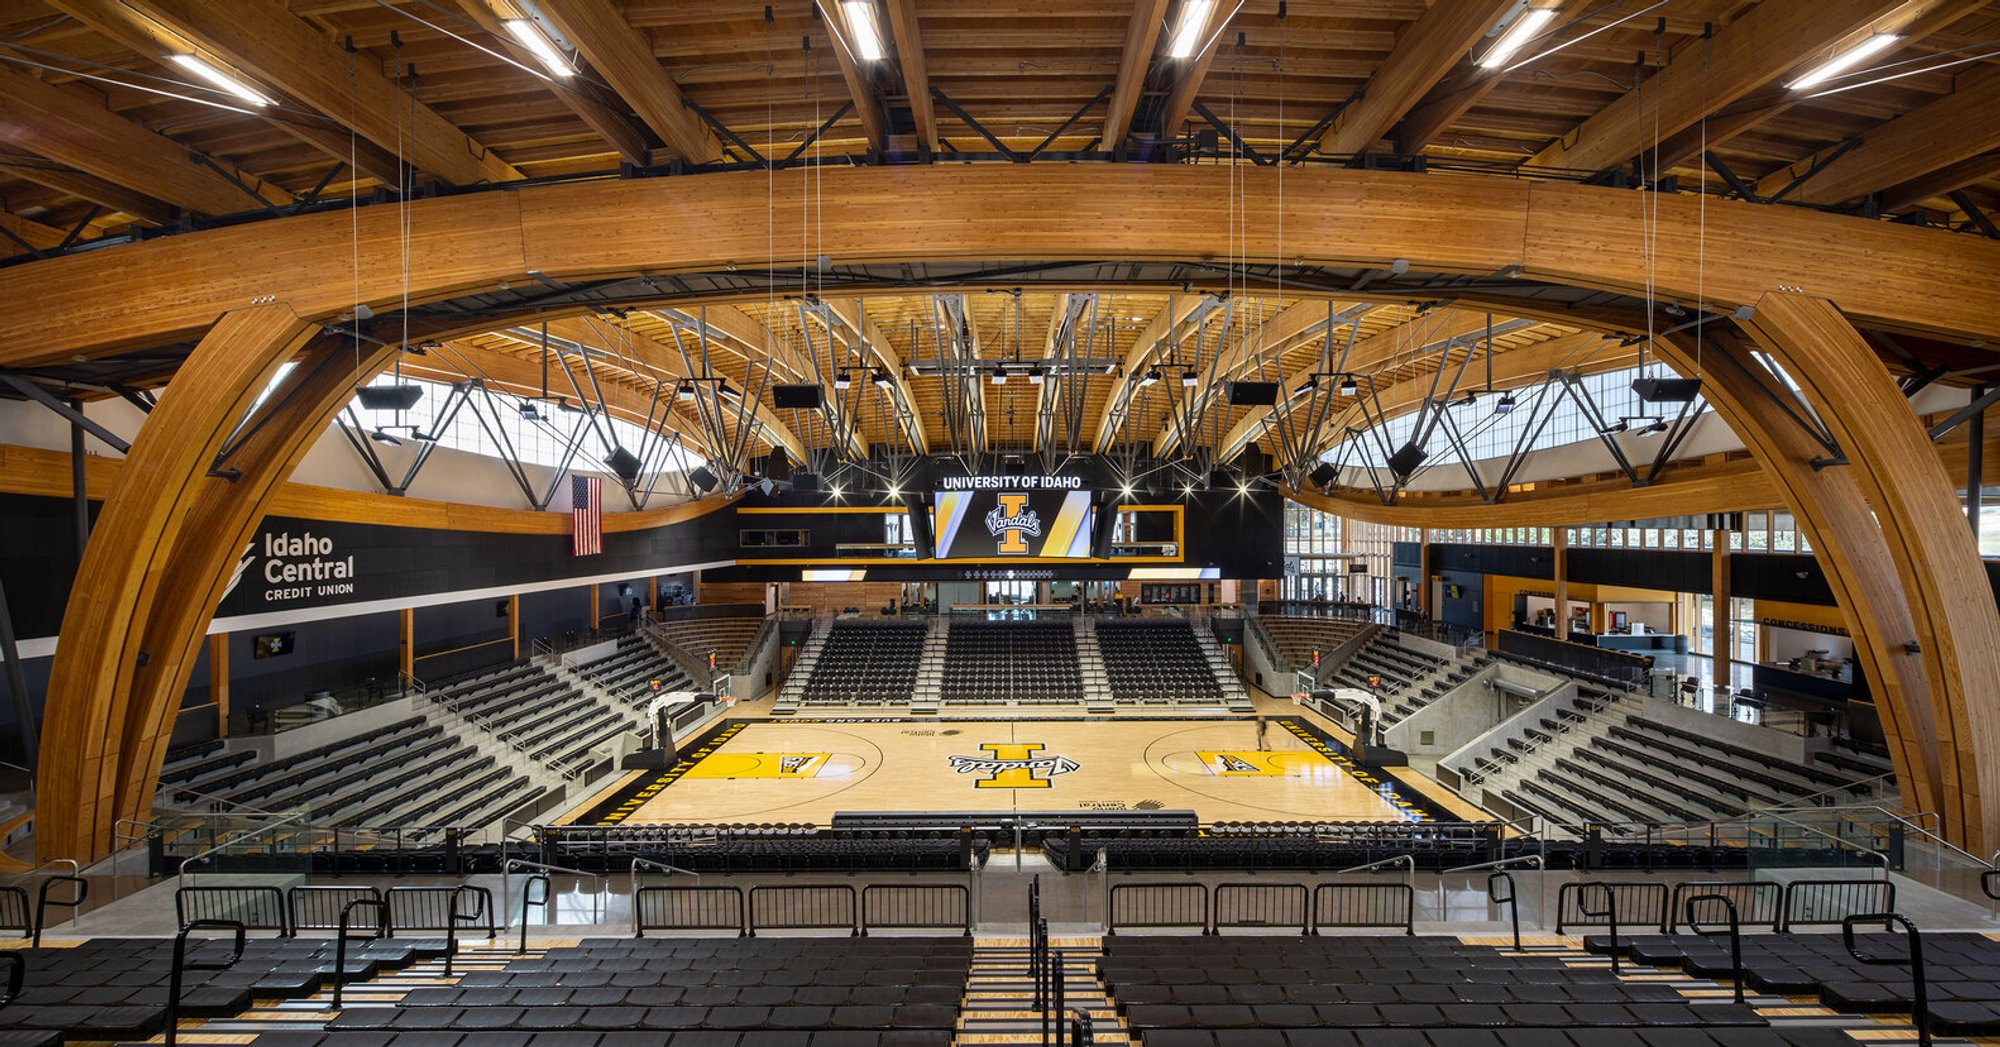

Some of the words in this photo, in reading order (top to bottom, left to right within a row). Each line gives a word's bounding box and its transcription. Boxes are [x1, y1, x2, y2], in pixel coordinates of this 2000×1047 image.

[943, 476, 1019, 489] UNIVERSITY
[1021, 476, 1038, 488] OF
[1041, 476, 1081, 488] IDAHO
[986, 510, 1040, 536] Vandals
[265, 531, 333, 557] Idaho
[264, 555, 354, 583] Central
[265, 587, 312, 601] CREDIT
[317, 583, 354, 596] UNION
[1763, 616, 1846, 635] CONCESSIONS
[691, 748, 712, 759] OF
[708, 723, 746, 745] IDAHO
[1280, 720, 1356, 767] UNIVERSITY
[1352, 771, 1379, 784] OF
[948, 755, 1081, 777] Vandals
